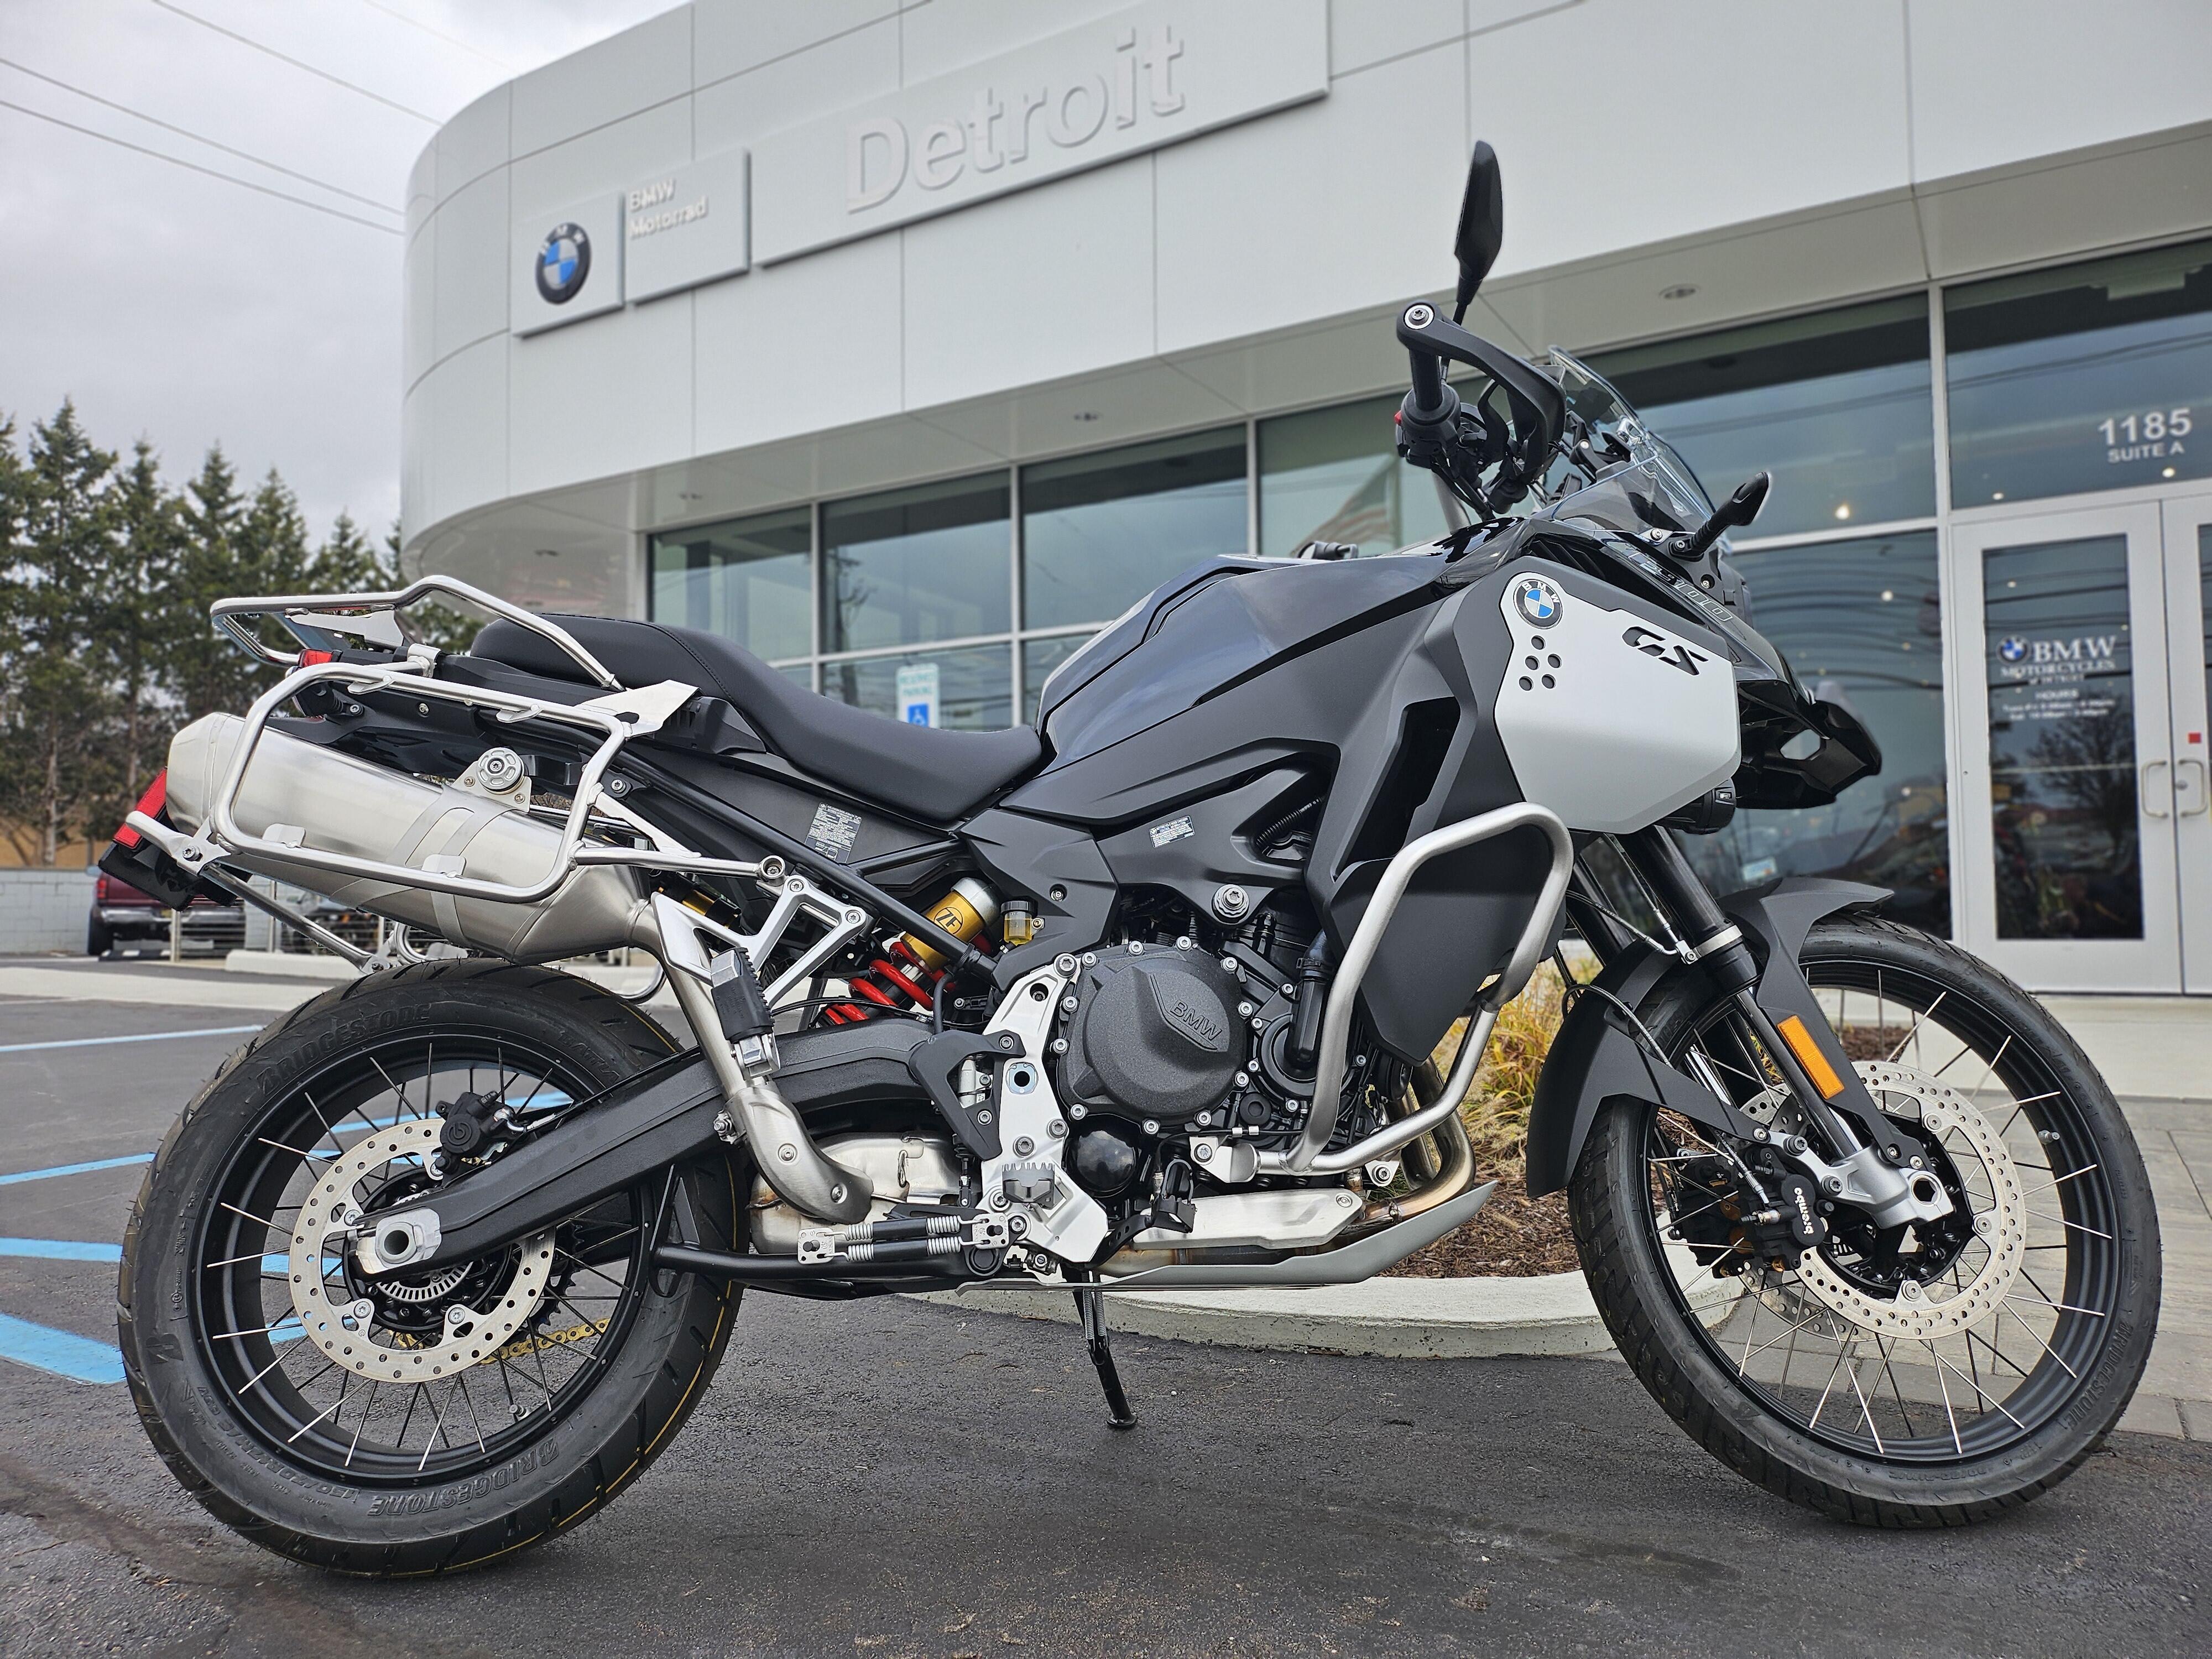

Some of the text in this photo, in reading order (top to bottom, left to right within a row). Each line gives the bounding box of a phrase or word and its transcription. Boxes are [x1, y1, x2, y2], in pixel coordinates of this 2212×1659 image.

[846, 23, 1186, 215] Detroit
[629, 180, 676, 213] BMW
[629, 195, 708, 239] Motorrad
[2098, 407, 2193, 446] 1185
[2107, 440, 2185, 463] SUITE A
[1622, 626, 1709, 676] GS
[2032, 635, 2116, 662] BMW
[1170, 999, 1223, 1041] BMW
[255, 1001, 432, 1097] BRIDGESTONE
[1794, 1187, 1814, 1234] brembo
[367, 1438, 559, 1516] BRIDGESTONE
